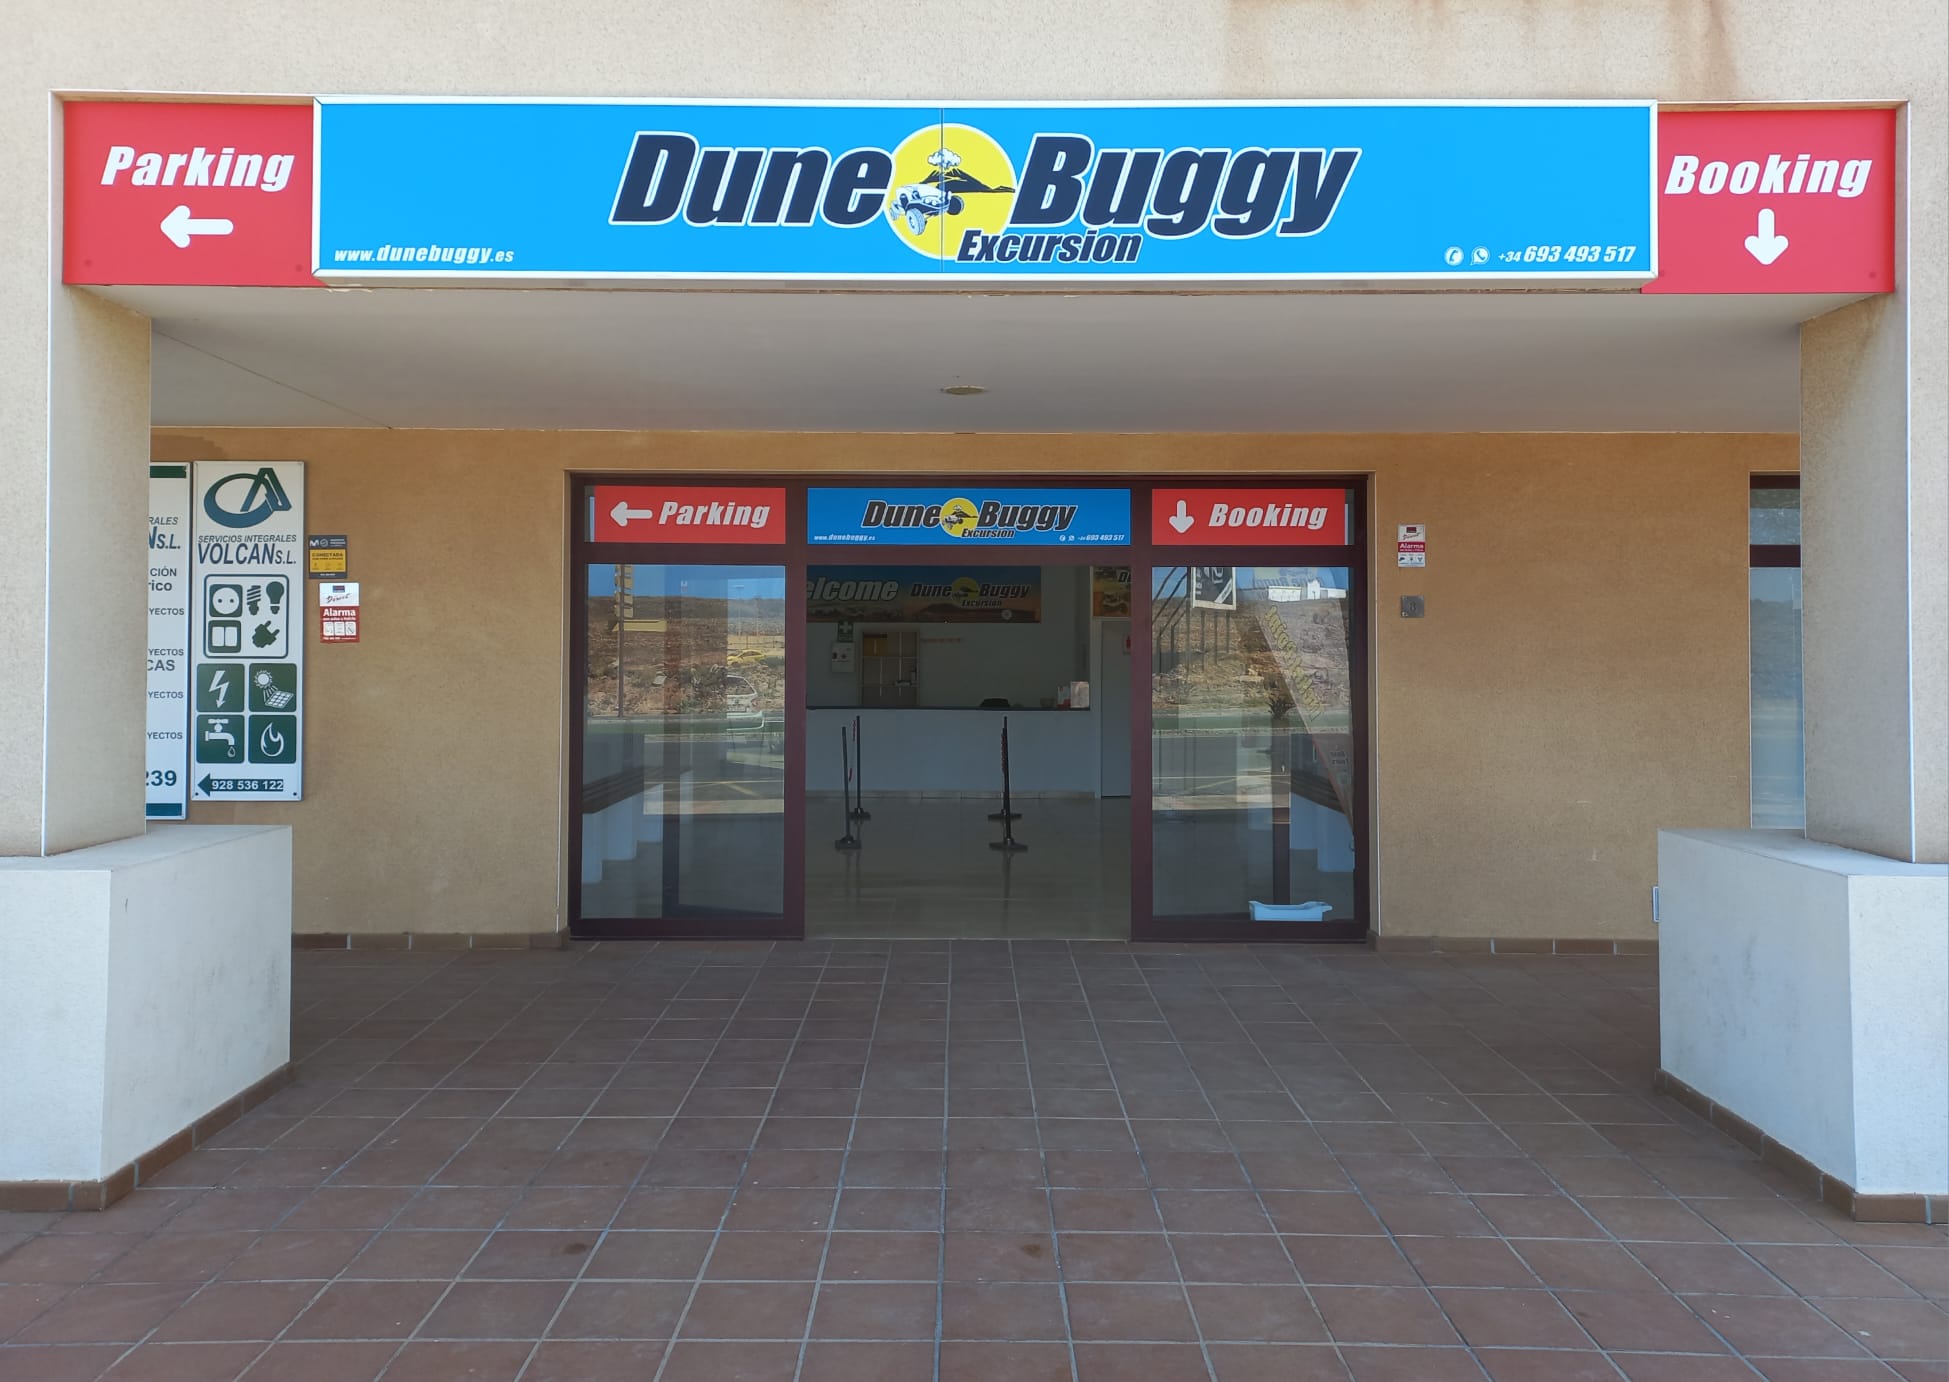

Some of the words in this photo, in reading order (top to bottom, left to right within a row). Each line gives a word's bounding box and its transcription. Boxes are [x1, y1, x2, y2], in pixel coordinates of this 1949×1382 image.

[100, 146, 295, 192] Parking
[1664, 154, 1873, 197] Booking
[608, 130, 896, 229] Dune
[1006, 132, 1363, 239] Buggy
[334, 244, 514, 264] www.dunebuggy.es
[954, 226, 1143, 264] Excursion
[1498, 251, 1522, 263] +34
[1523, 245, 1562, 263] 693
[1564, 245, 1602, 263] 493
[1604, 245, 1637, 263] 517
[658, 502, 770, 529] Parking
[861, 499, 942, 529] Dune
[977, 500, 1079, 531] Buggy
[1208, 503, 1328, 530] Booking
[198, 535, 243, 543] SERVICIOS
[244, 534, 297, 542] INTEGRALES
[961, 527, 1015, 539] Excursion
[148, 579, 173, 591] ico
[910, 583, 952, 598] Dune
[978, 583, 1034, 599] Buggy
[322, 607, 356, 617] Alarma
[211, 779, 234, 791] 928
[237, 779, 259, 791] 536
[262, 779, 284, 791] 122
